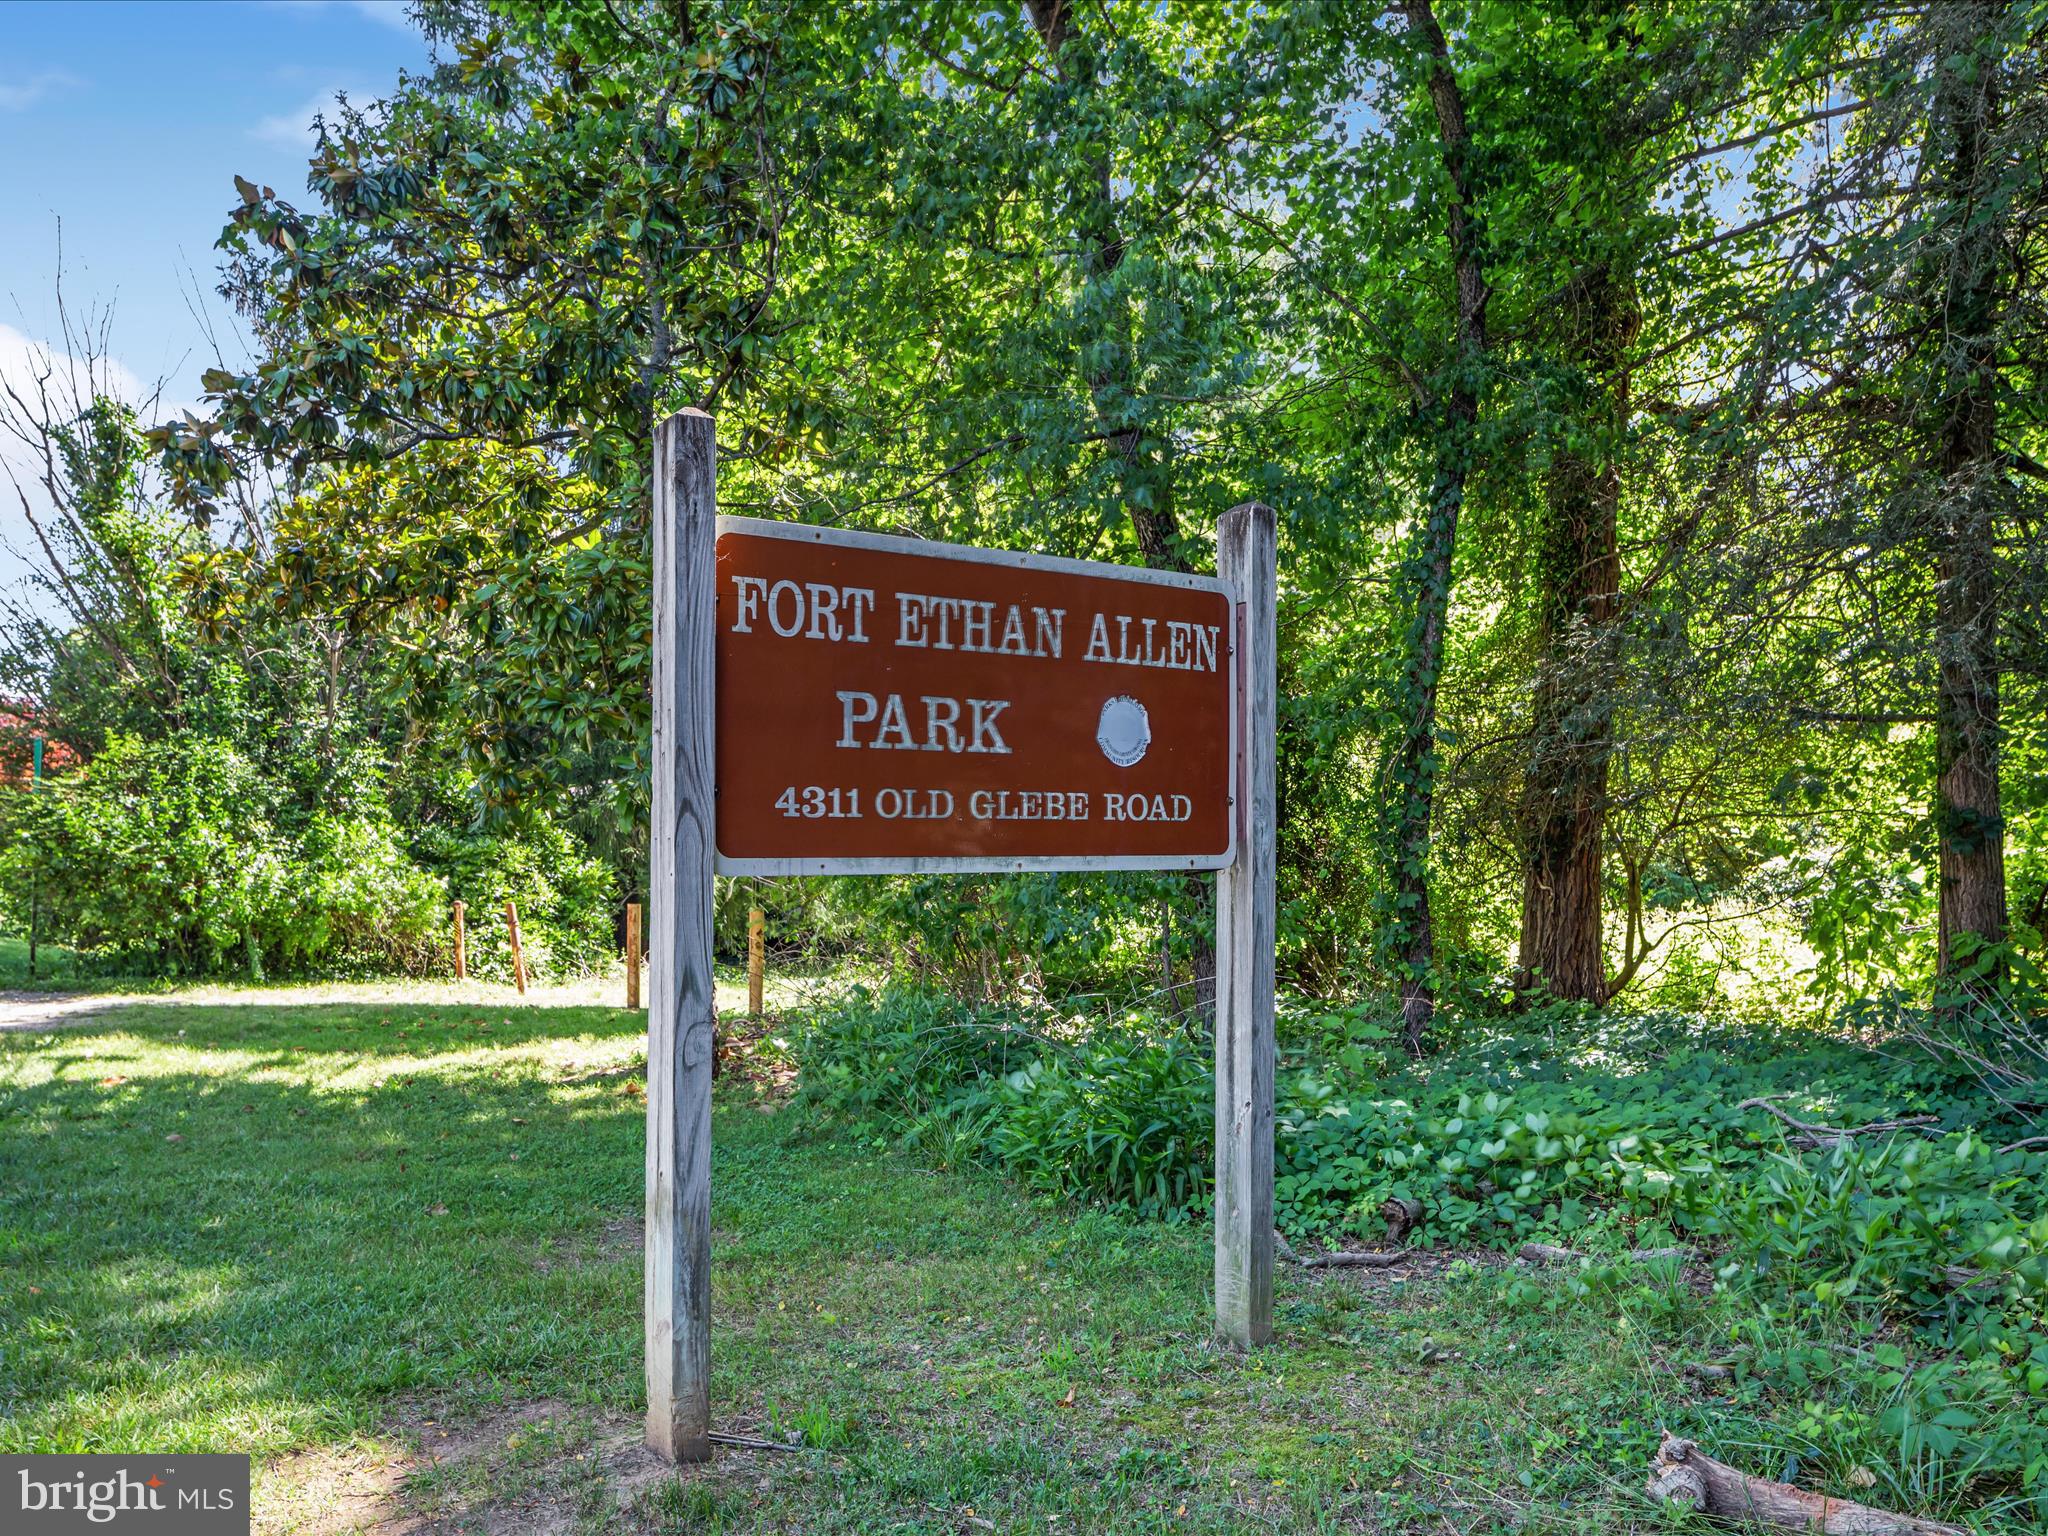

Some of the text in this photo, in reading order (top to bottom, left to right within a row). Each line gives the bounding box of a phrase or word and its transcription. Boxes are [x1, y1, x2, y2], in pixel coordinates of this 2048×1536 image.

[731, 575, 1220, 673] FORT ETHAN ALLEN
[836, 690, 1012, 754] PARK
[775, 786, 1192, 822] 4311 OLD GLEBE ROAD
